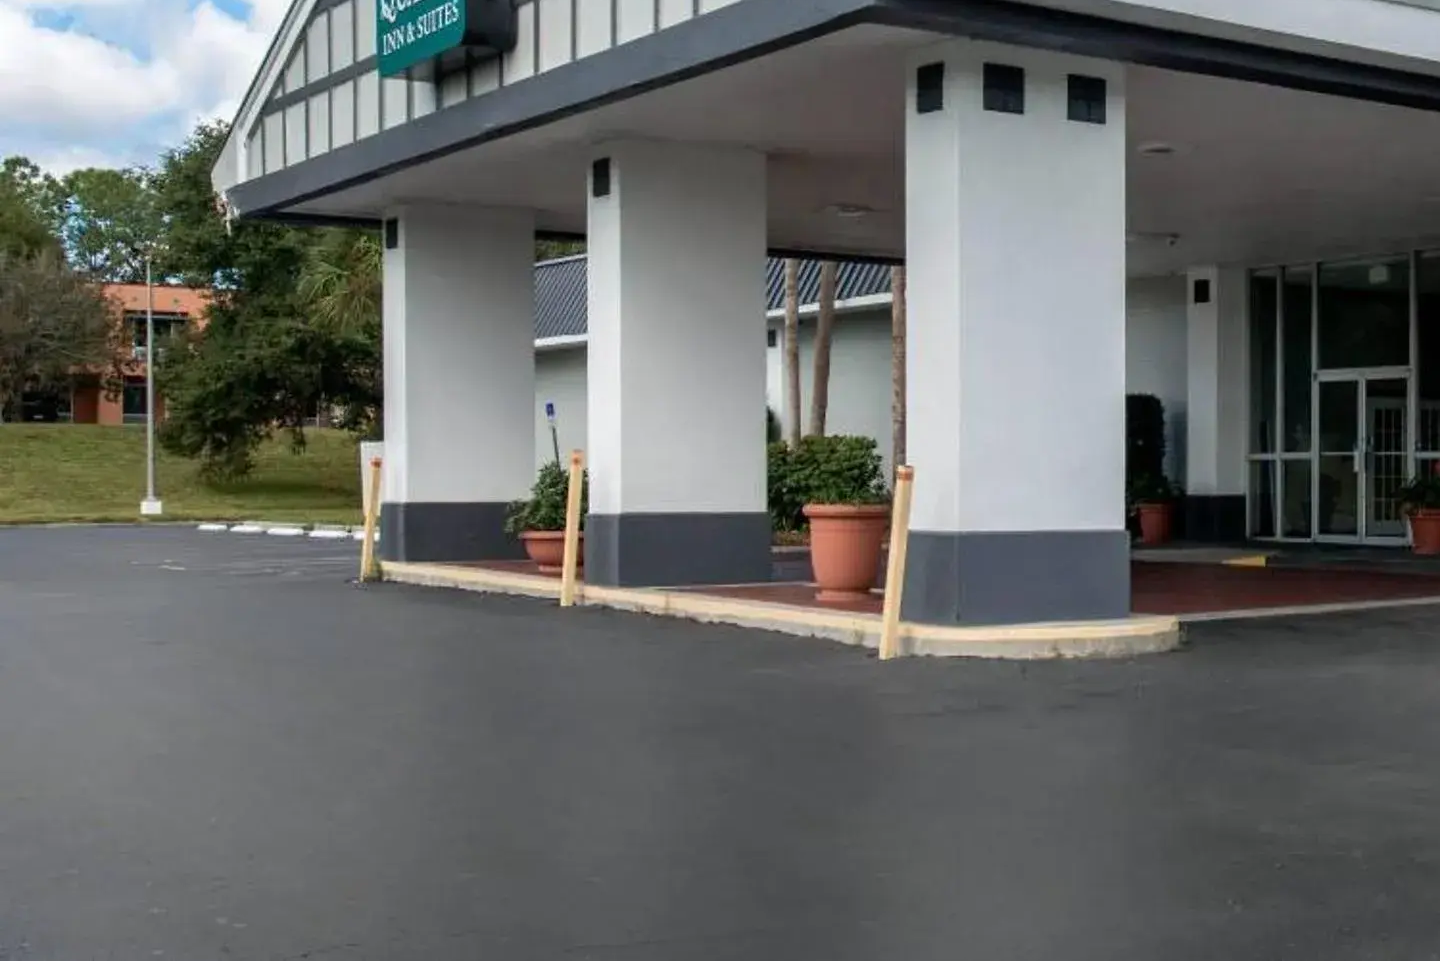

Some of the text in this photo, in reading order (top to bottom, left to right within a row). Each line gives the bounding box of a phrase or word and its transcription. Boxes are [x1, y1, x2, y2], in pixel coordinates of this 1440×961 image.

[383, 0, 460, 56] INN & SUITES
